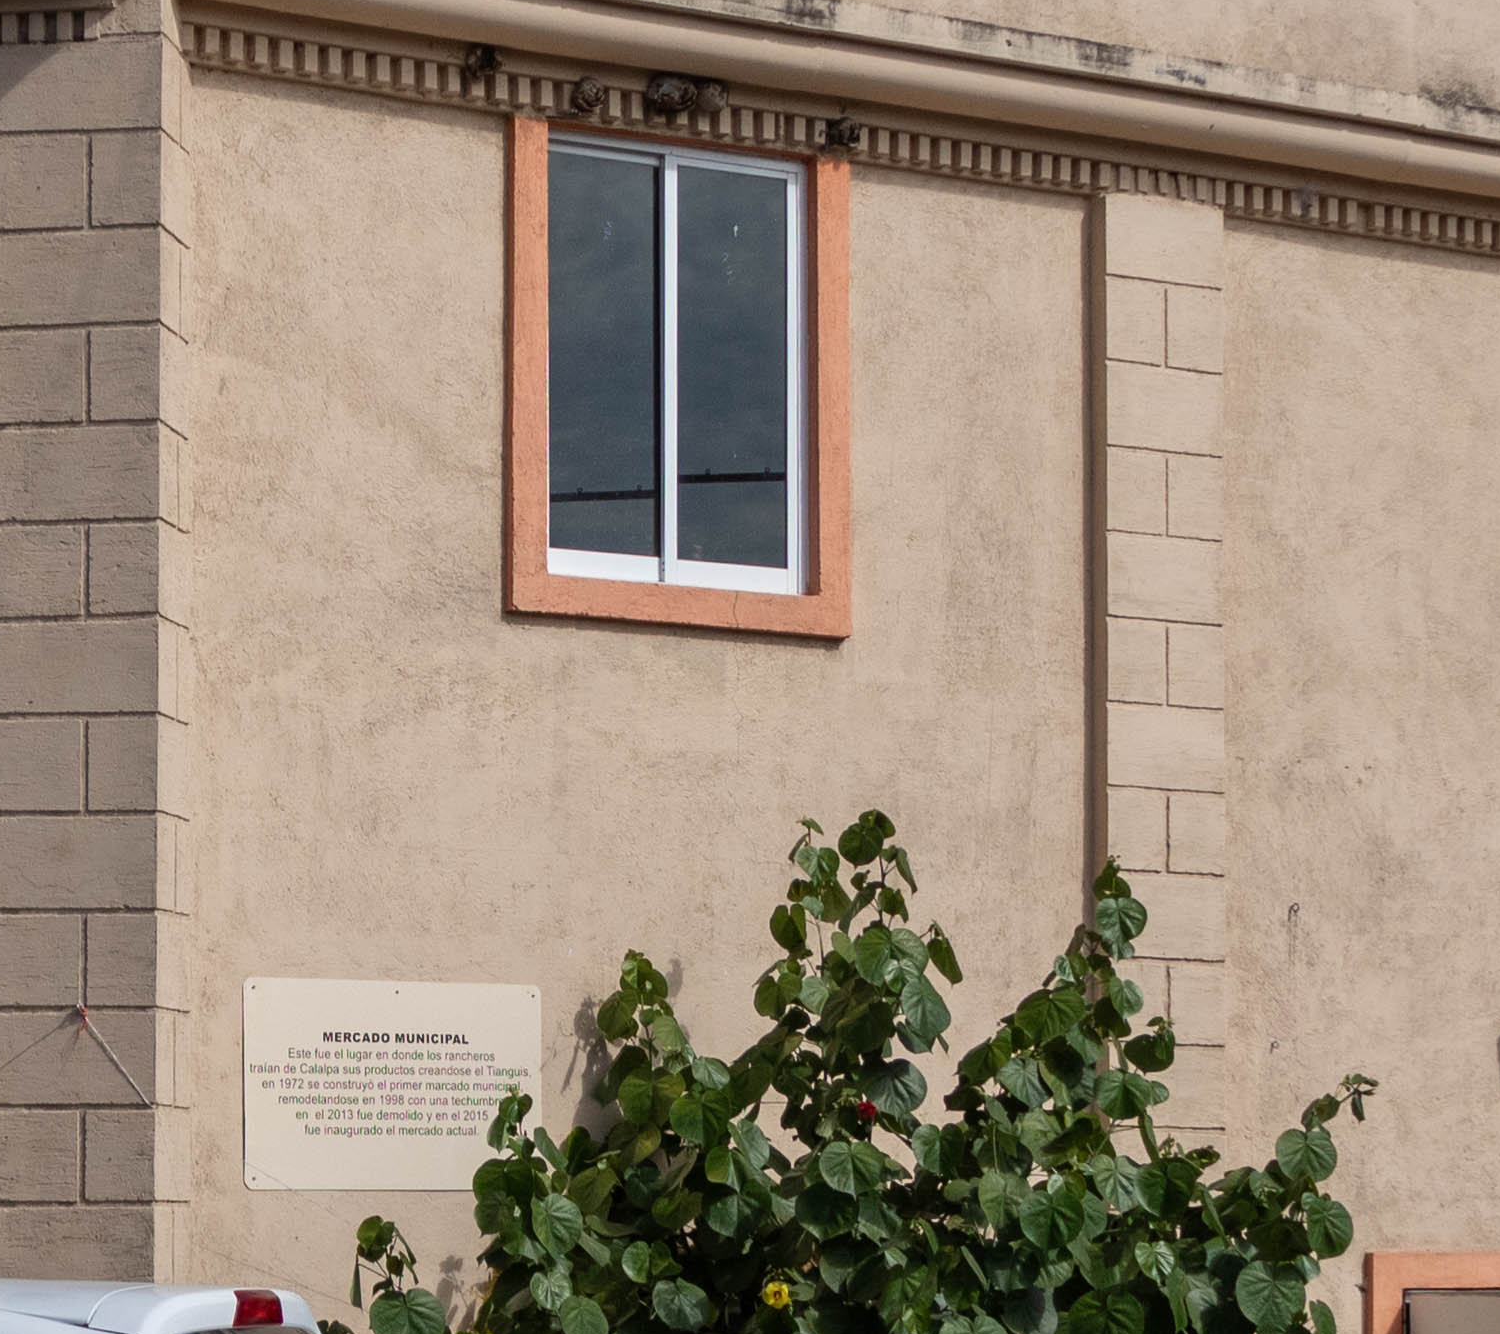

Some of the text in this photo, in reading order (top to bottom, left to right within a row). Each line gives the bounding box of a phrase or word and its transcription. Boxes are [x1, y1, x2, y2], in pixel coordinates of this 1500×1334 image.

[322, 1031, 469, 1045] MERCADO MUNICIPAL
[288, 1047, 495, 1062] Este fue el lugar en donde los rancheros
[283, 1063, 297, 1074] de
[342, 1066, 361, 1075] sus
[364, 1064, 415, 1076] productos
[418, 1065, 471, 1076] creandose
[474, 1066, 484, 1076] el
[261, 1080, 275, 1089] en
[280, 1078, 304, 1089] 1972
[307, 1080, 320, 1089] se
[322, 1079, 374, 1092] construyó
[377, 1080, 387, 1090] el
[389, 1080, 422, 1092] primer
[425, 1080, 470, 1091] marcado
[278, 1094, 359, 1105] remodelandose
[362, 1096, 376, 1105] en
[380, 1094, 405, 1105] 1998
[407, 1096, 427, 1106] con
[429, 1096, 449, 1106] una
[295, 1109, 489, 1123] en el 2013 fue demolido y en el 2015
[304, 1124, 320, 1135] fue
[323, 1125, 383, 1137] inaugurado
[386, 1125, 395, 1136] el
[398, 1125, 443, 1136] mercado
